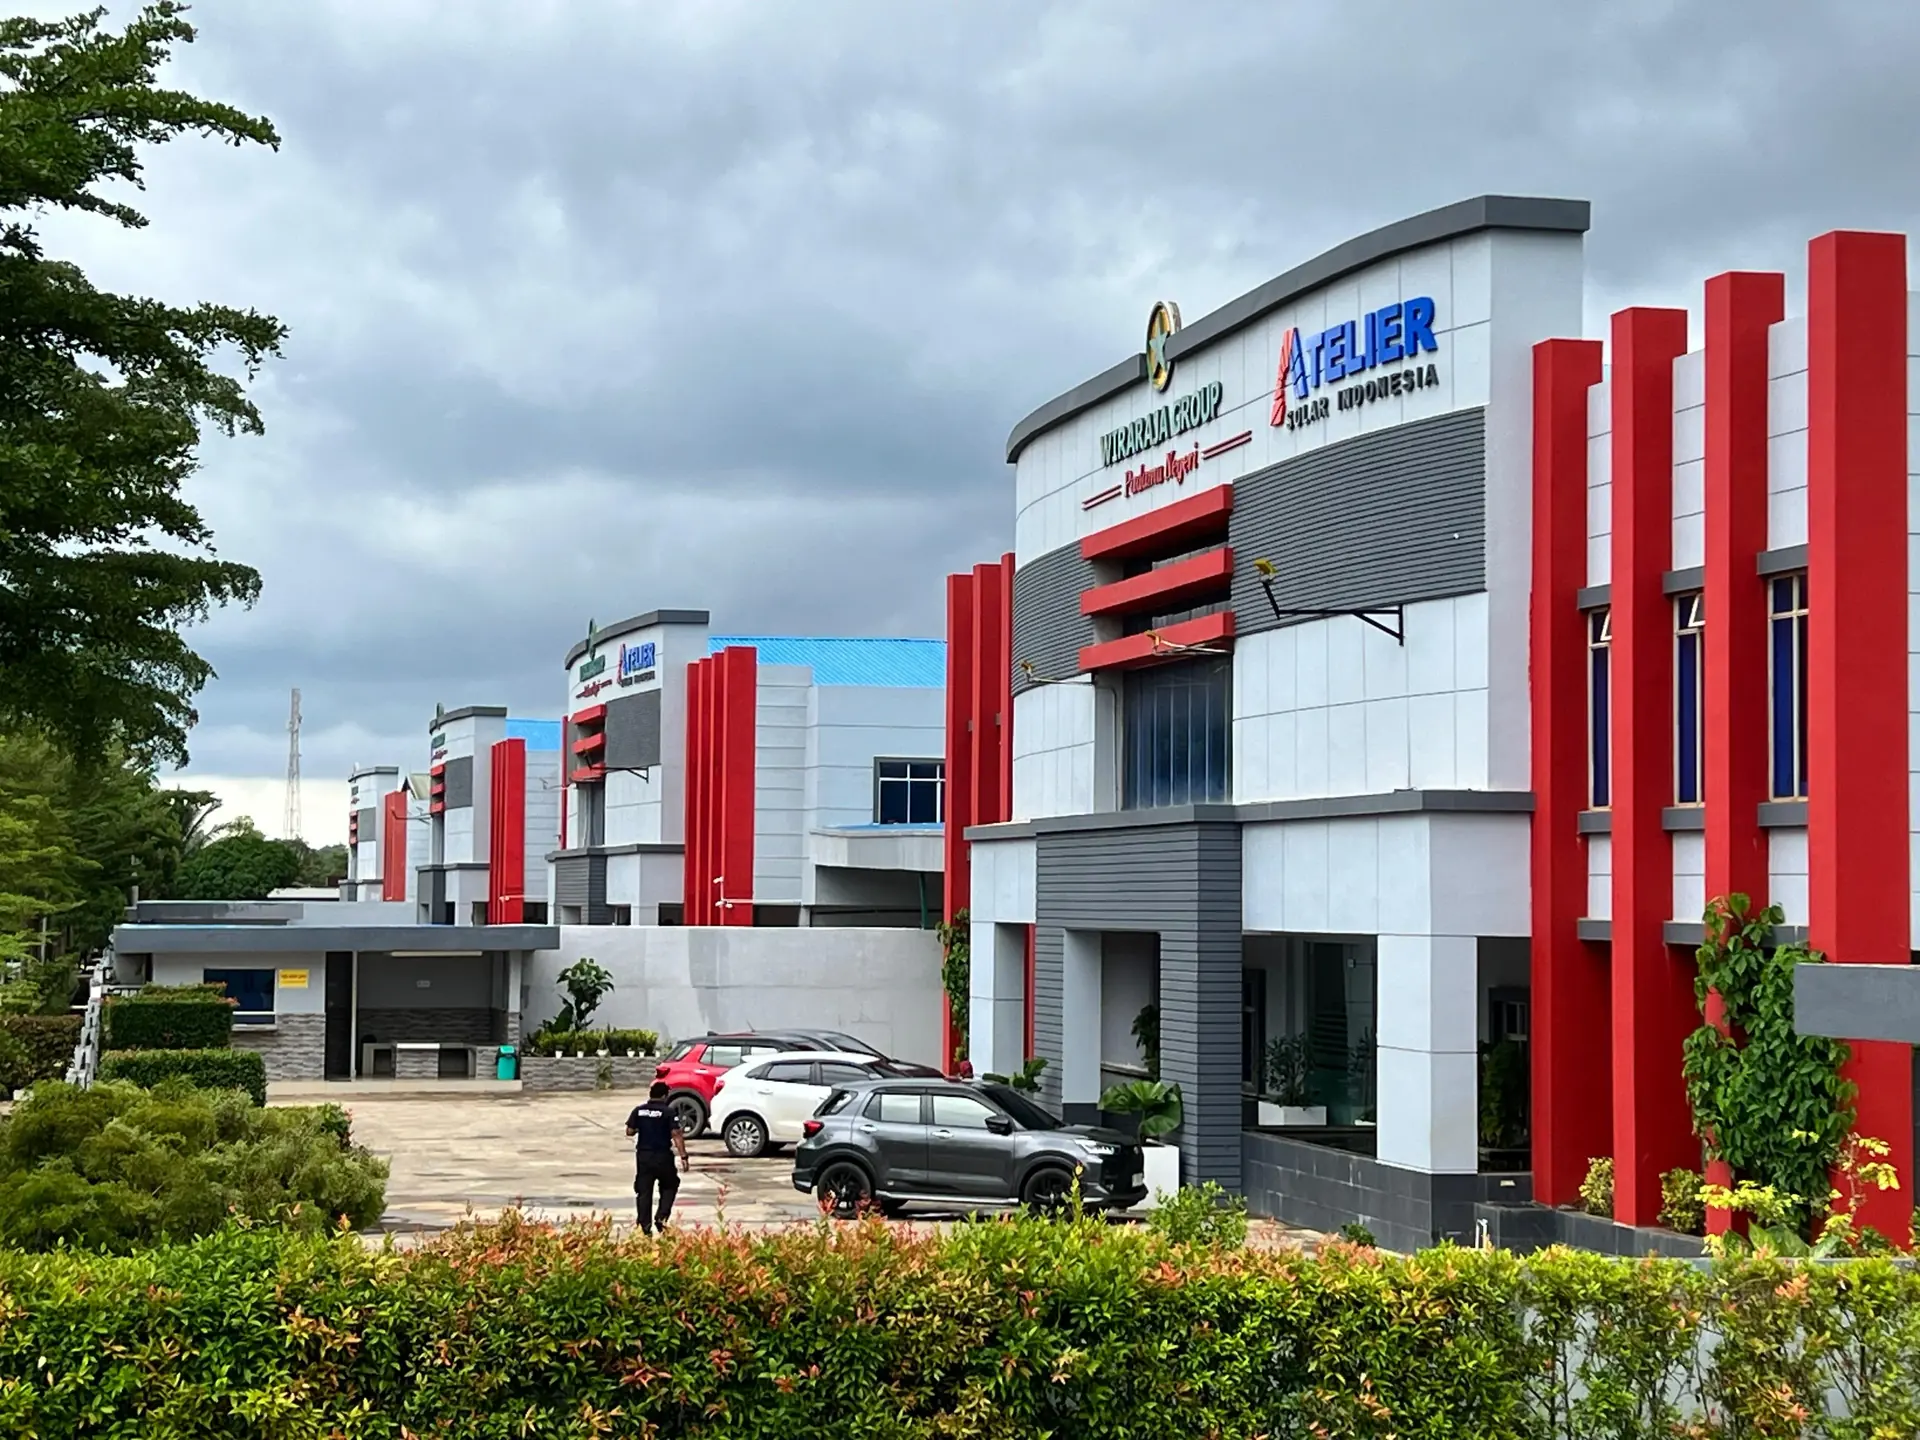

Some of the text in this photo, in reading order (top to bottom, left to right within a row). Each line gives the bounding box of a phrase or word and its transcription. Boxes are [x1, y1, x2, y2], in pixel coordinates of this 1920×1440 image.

[1270, 296, 1438, 427] ATELIER
[1286, 363, 1440, 431] SOLAR INDONESIA
[1100, 381, 1223, 468] WIRARAJA GROUP
